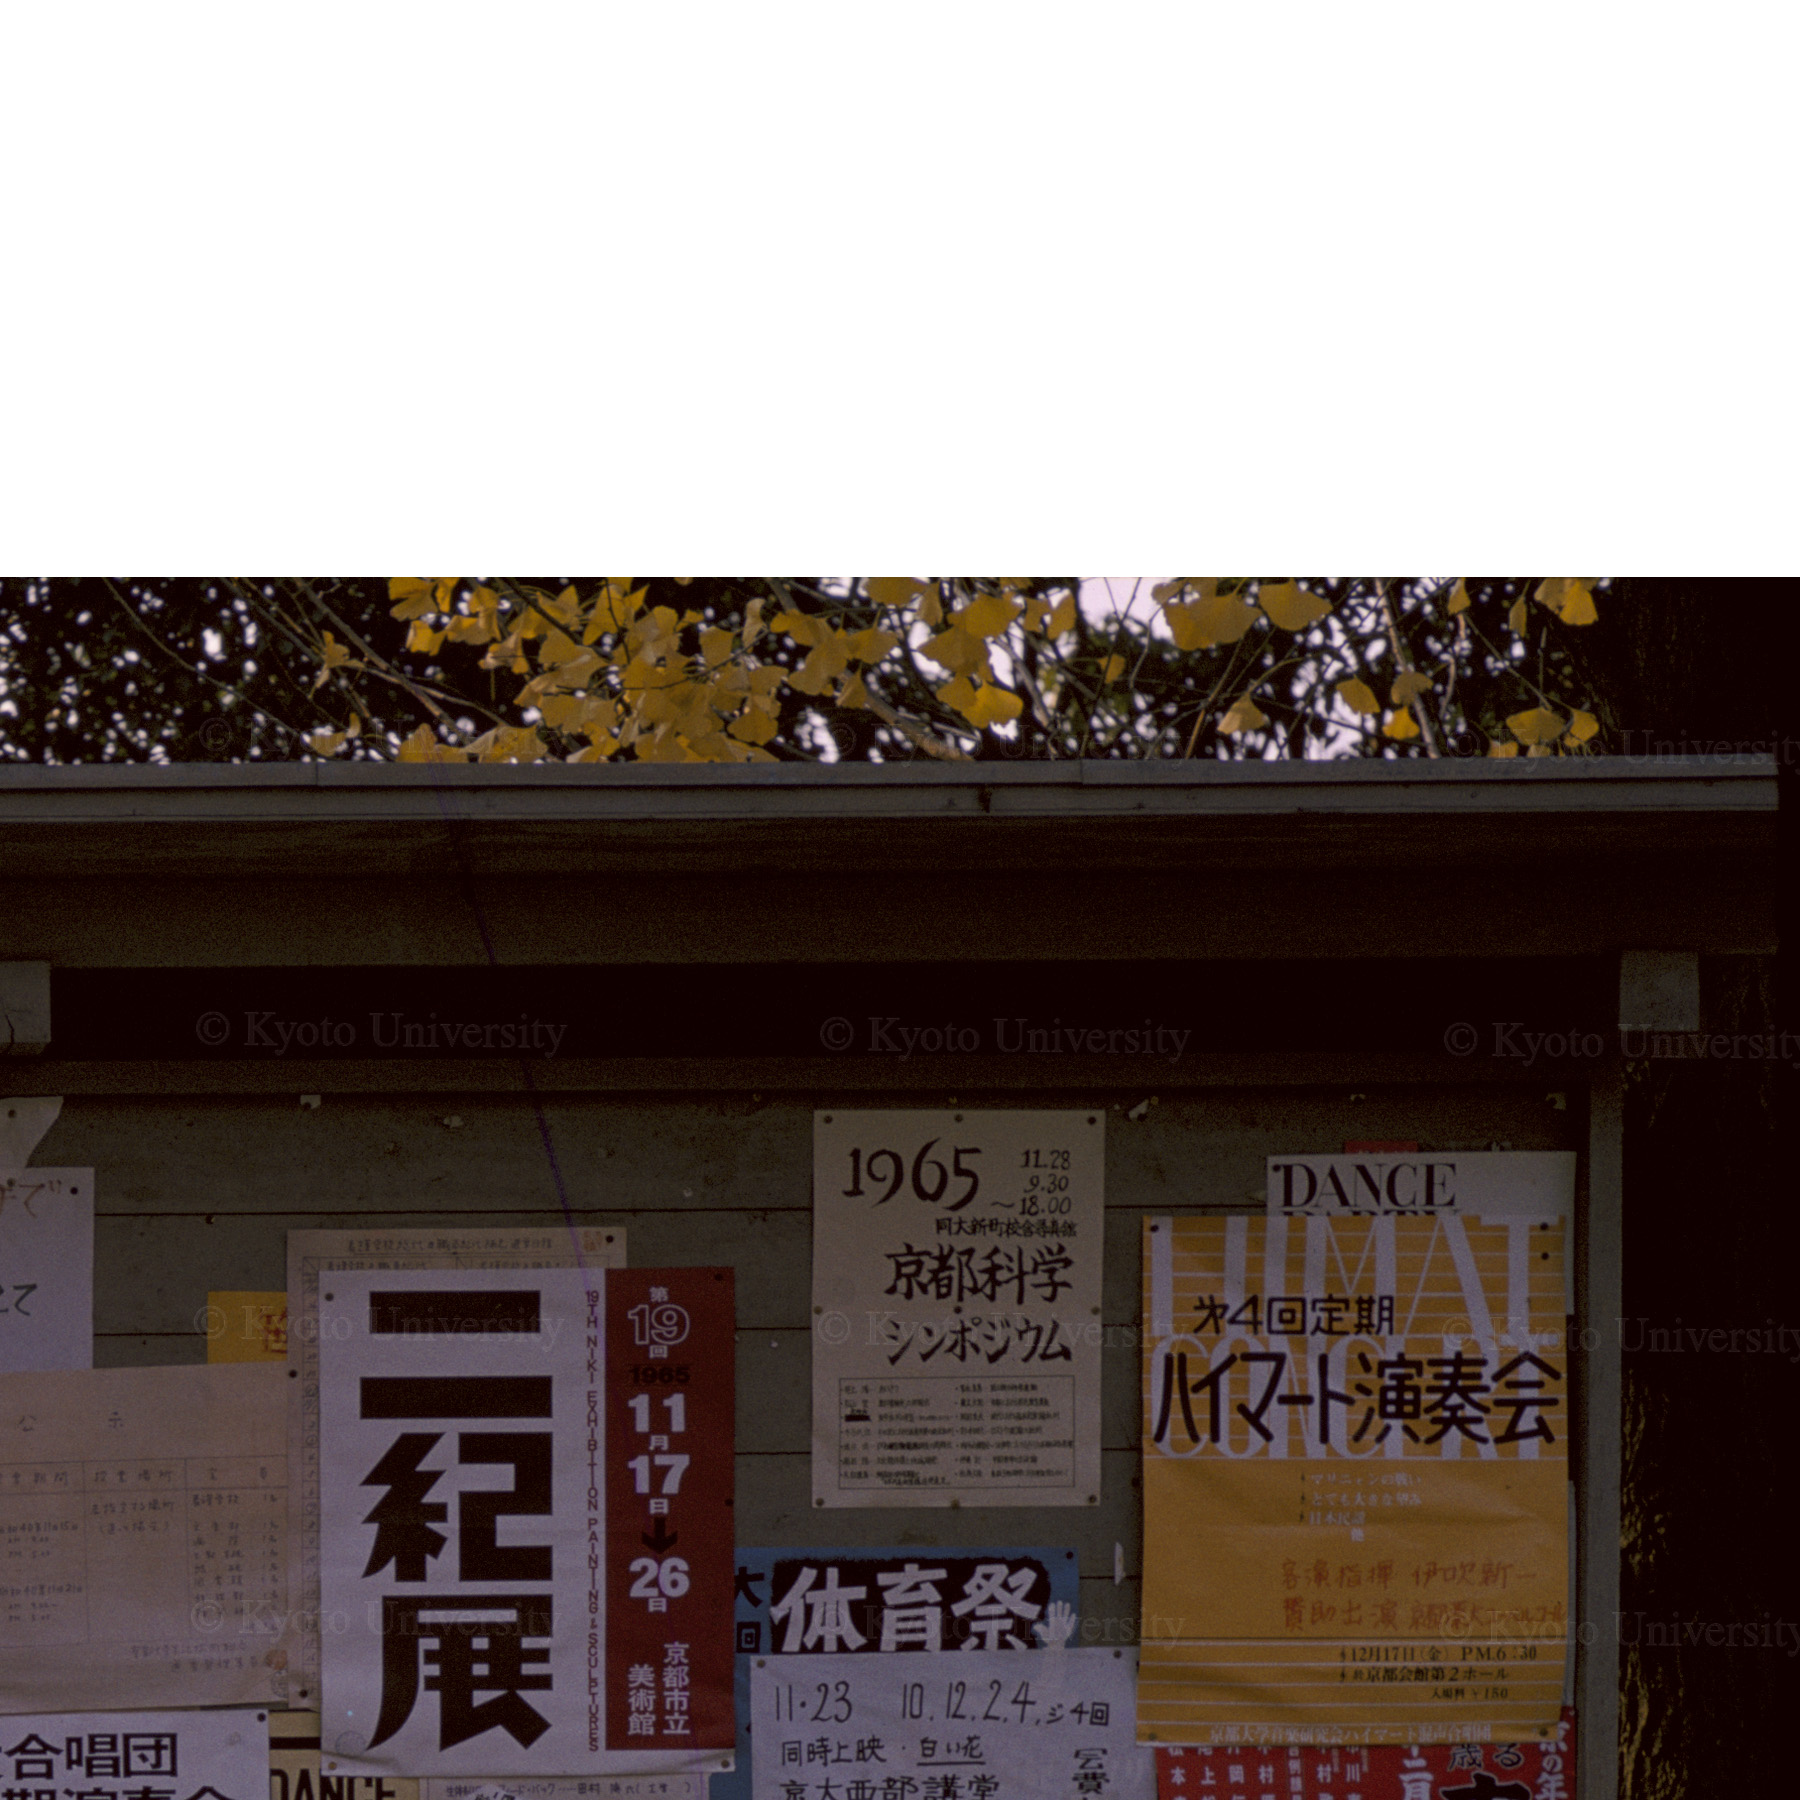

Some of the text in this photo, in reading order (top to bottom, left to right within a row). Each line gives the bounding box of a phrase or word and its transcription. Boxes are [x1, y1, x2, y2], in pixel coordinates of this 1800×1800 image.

[842, 1138, 982, 1211] 1965
[1280, 1162, 1457, 1207] DANCE
[885, 1243, 1074, 1304] 京都科学
[586, 1335, 598, 1385] NIKI
[885, 1317, 1072, 1365] シンポジウム
[359, 1290, 553, 1753] 二紀展
[769, 1563, 1042, 1652] 体育祭
[628, 1663, 656, 1736] 美術館
[663, 1641, 691, 1736] 京都市立
[782, 1737, 887, 1767] 同時上映
